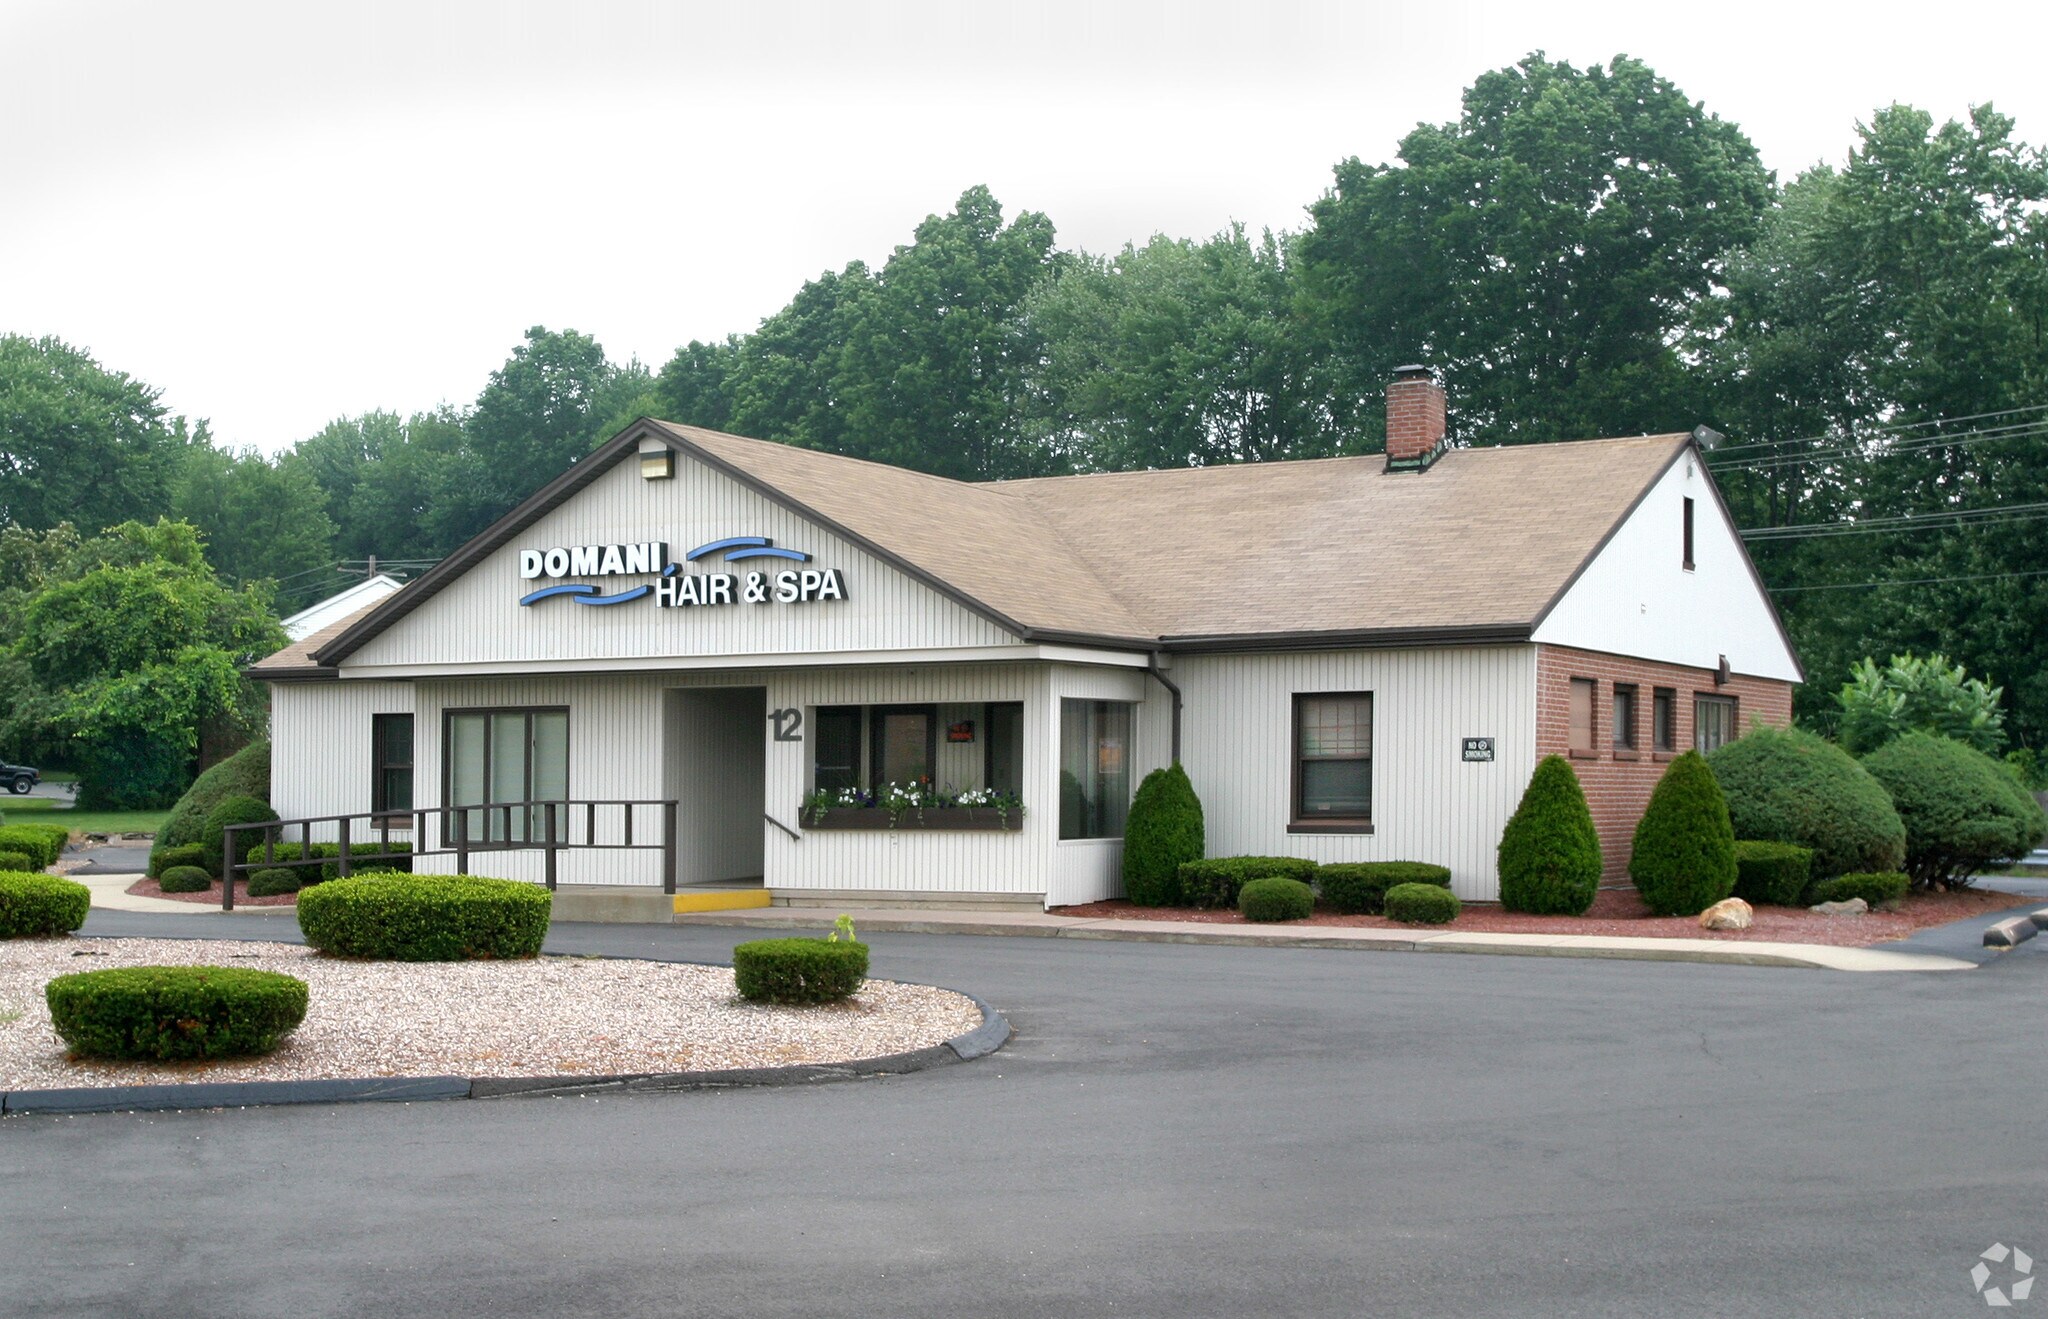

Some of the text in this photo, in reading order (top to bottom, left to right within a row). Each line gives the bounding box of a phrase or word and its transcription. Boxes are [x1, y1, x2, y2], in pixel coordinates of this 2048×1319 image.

[520, 542, 664, 580] DOMANI
[656, 569, 846, 608] HAIR & SPA
[768, 708, 802, 741] 12
[1465, 750, 1491, 758] SMOKING
[1468, 741, 1477, 750] NO
